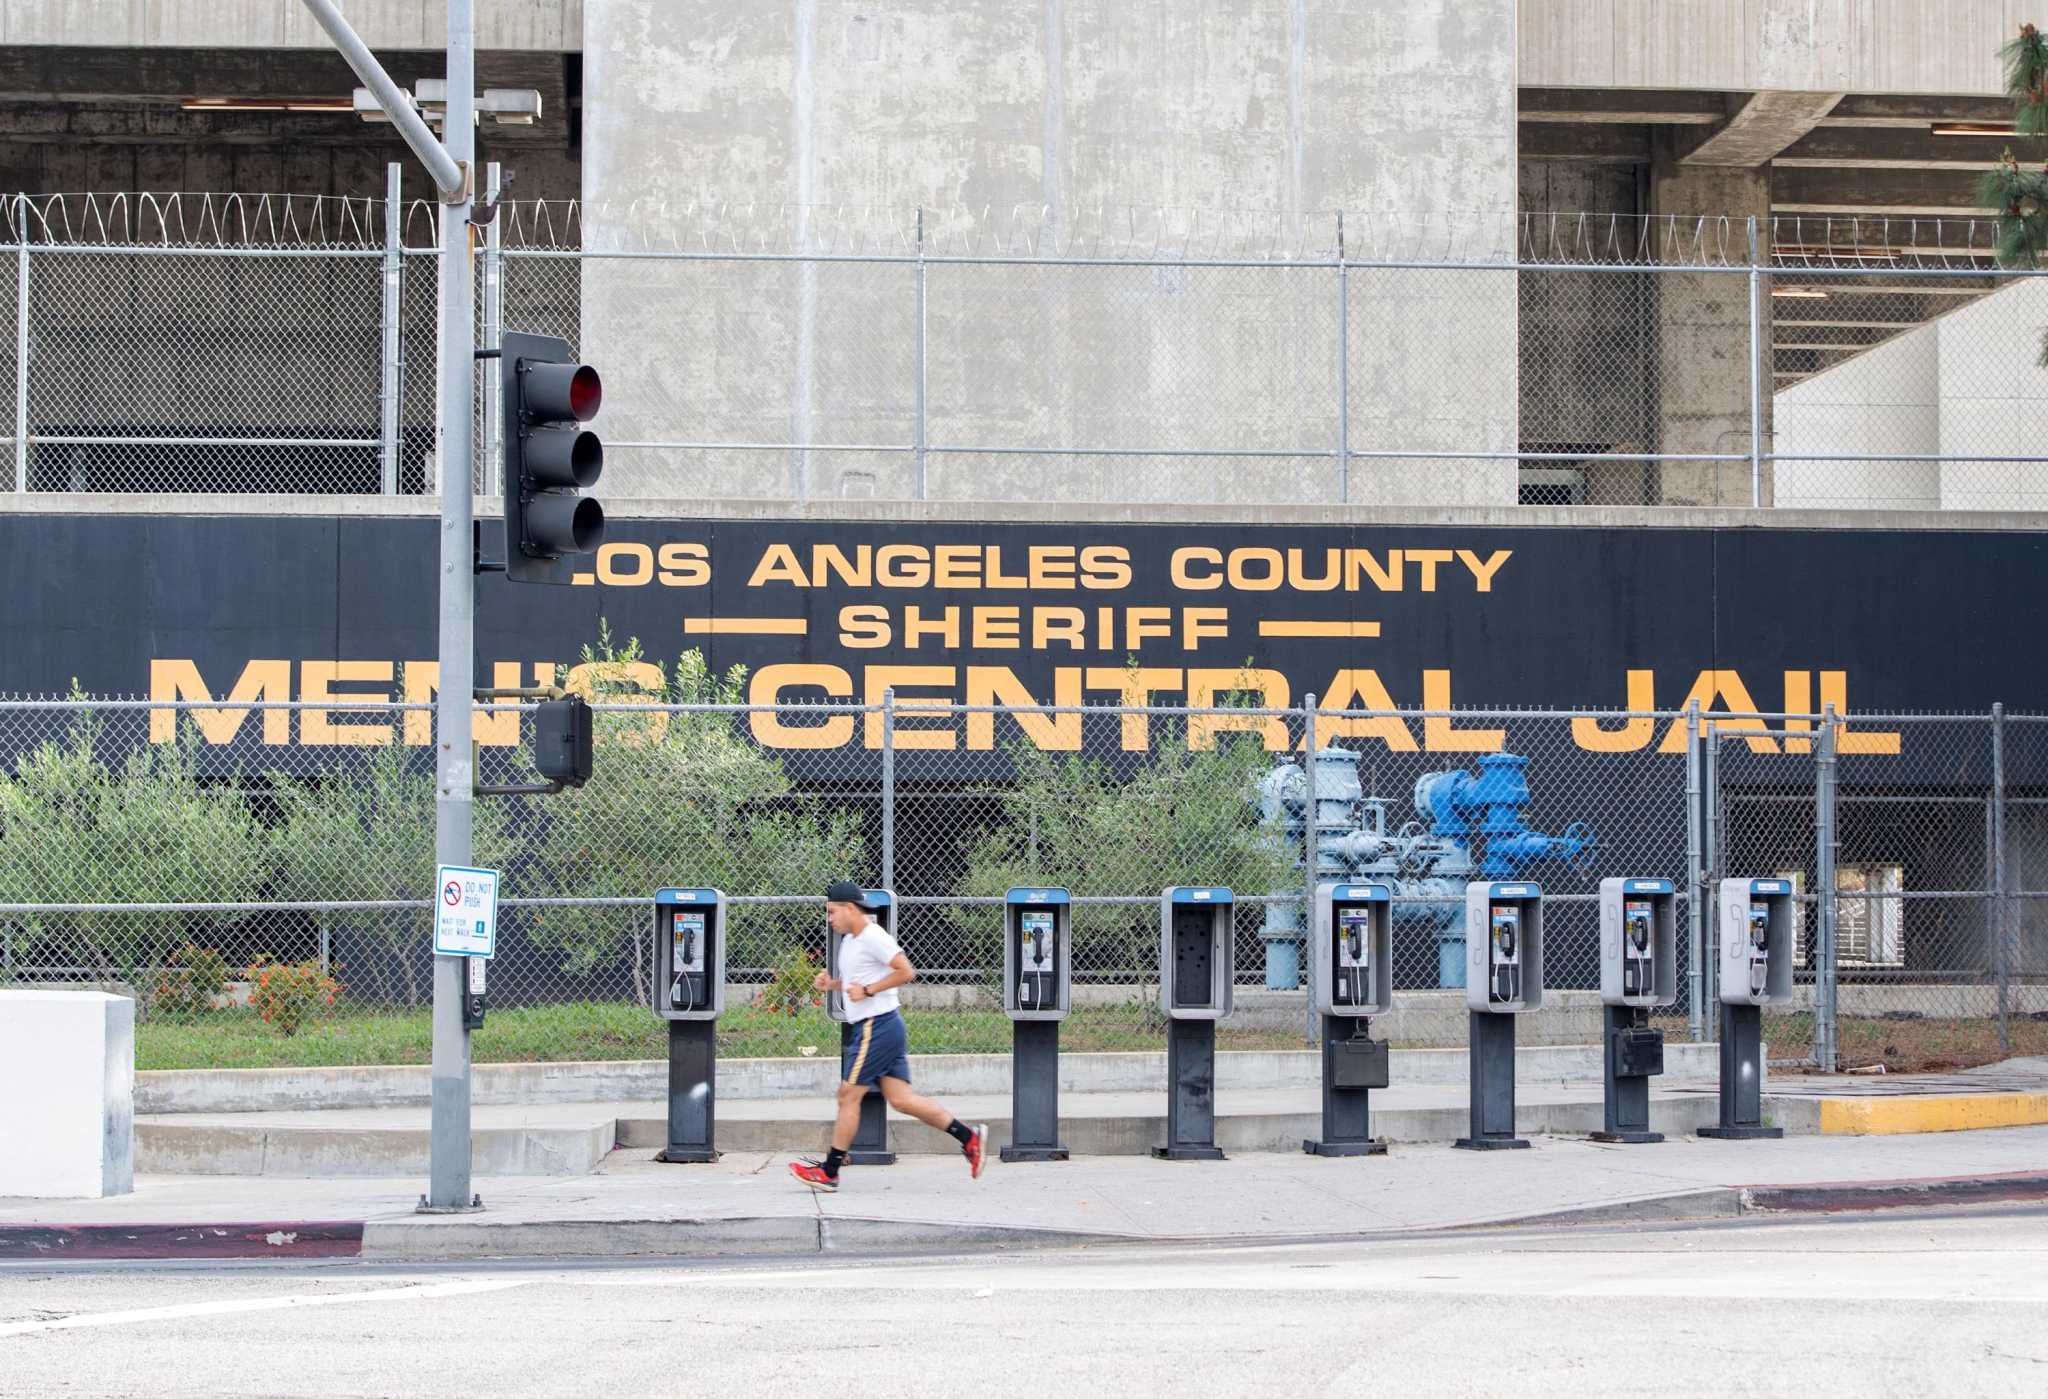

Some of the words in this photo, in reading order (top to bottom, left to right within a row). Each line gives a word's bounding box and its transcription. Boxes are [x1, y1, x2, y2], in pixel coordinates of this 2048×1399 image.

[748, 544, 1132, 589] ANGELES
[1171, 547, 1512, 592] COUNTY
[839, 605, 1229, 650] SHERIFF
[749, 664, 1505, 753] CENTRAL
[1572, 669, 1901, 755] JAIL
[464, 896, 480, 908] PUSH
[465, 881, 475, 893] DO
[479, 882, 491, 895] NOT
